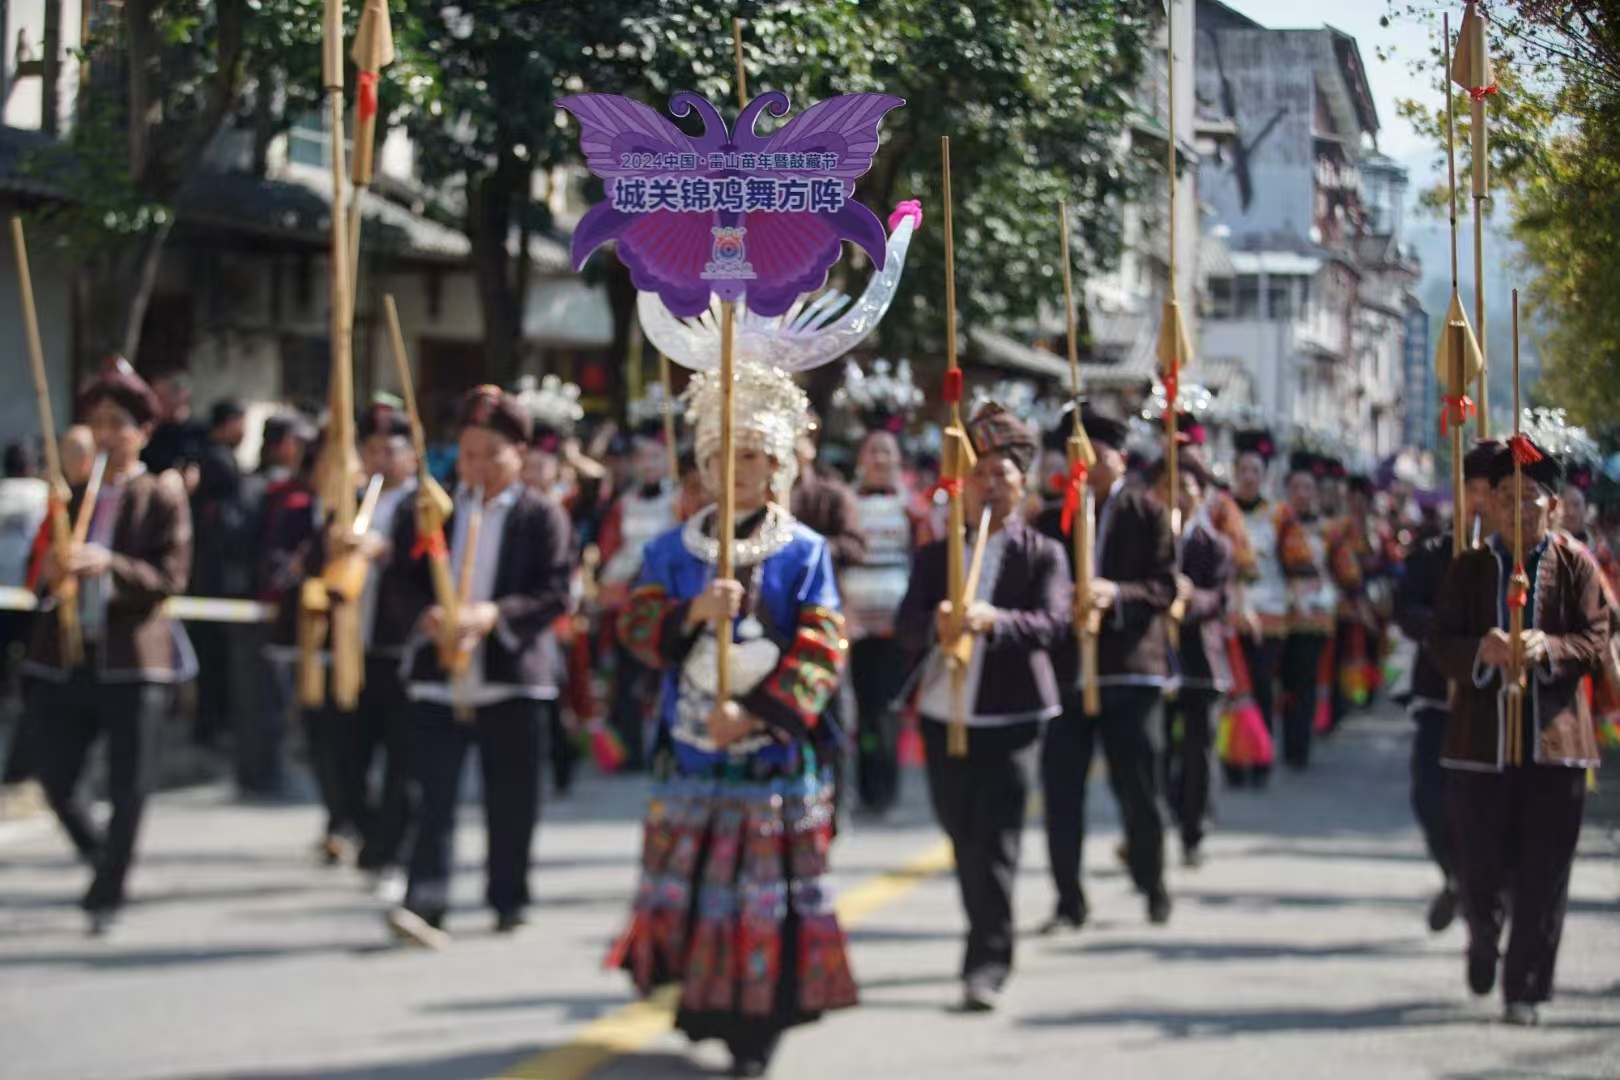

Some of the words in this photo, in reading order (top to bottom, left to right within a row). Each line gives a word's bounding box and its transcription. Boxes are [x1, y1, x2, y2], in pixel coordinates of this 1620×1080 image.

[621, 152, 838, 170] 2024中国·雷山苗年暨鼓藏节
[614, 178, 843, 212] 城关锦鸡舞方阵
